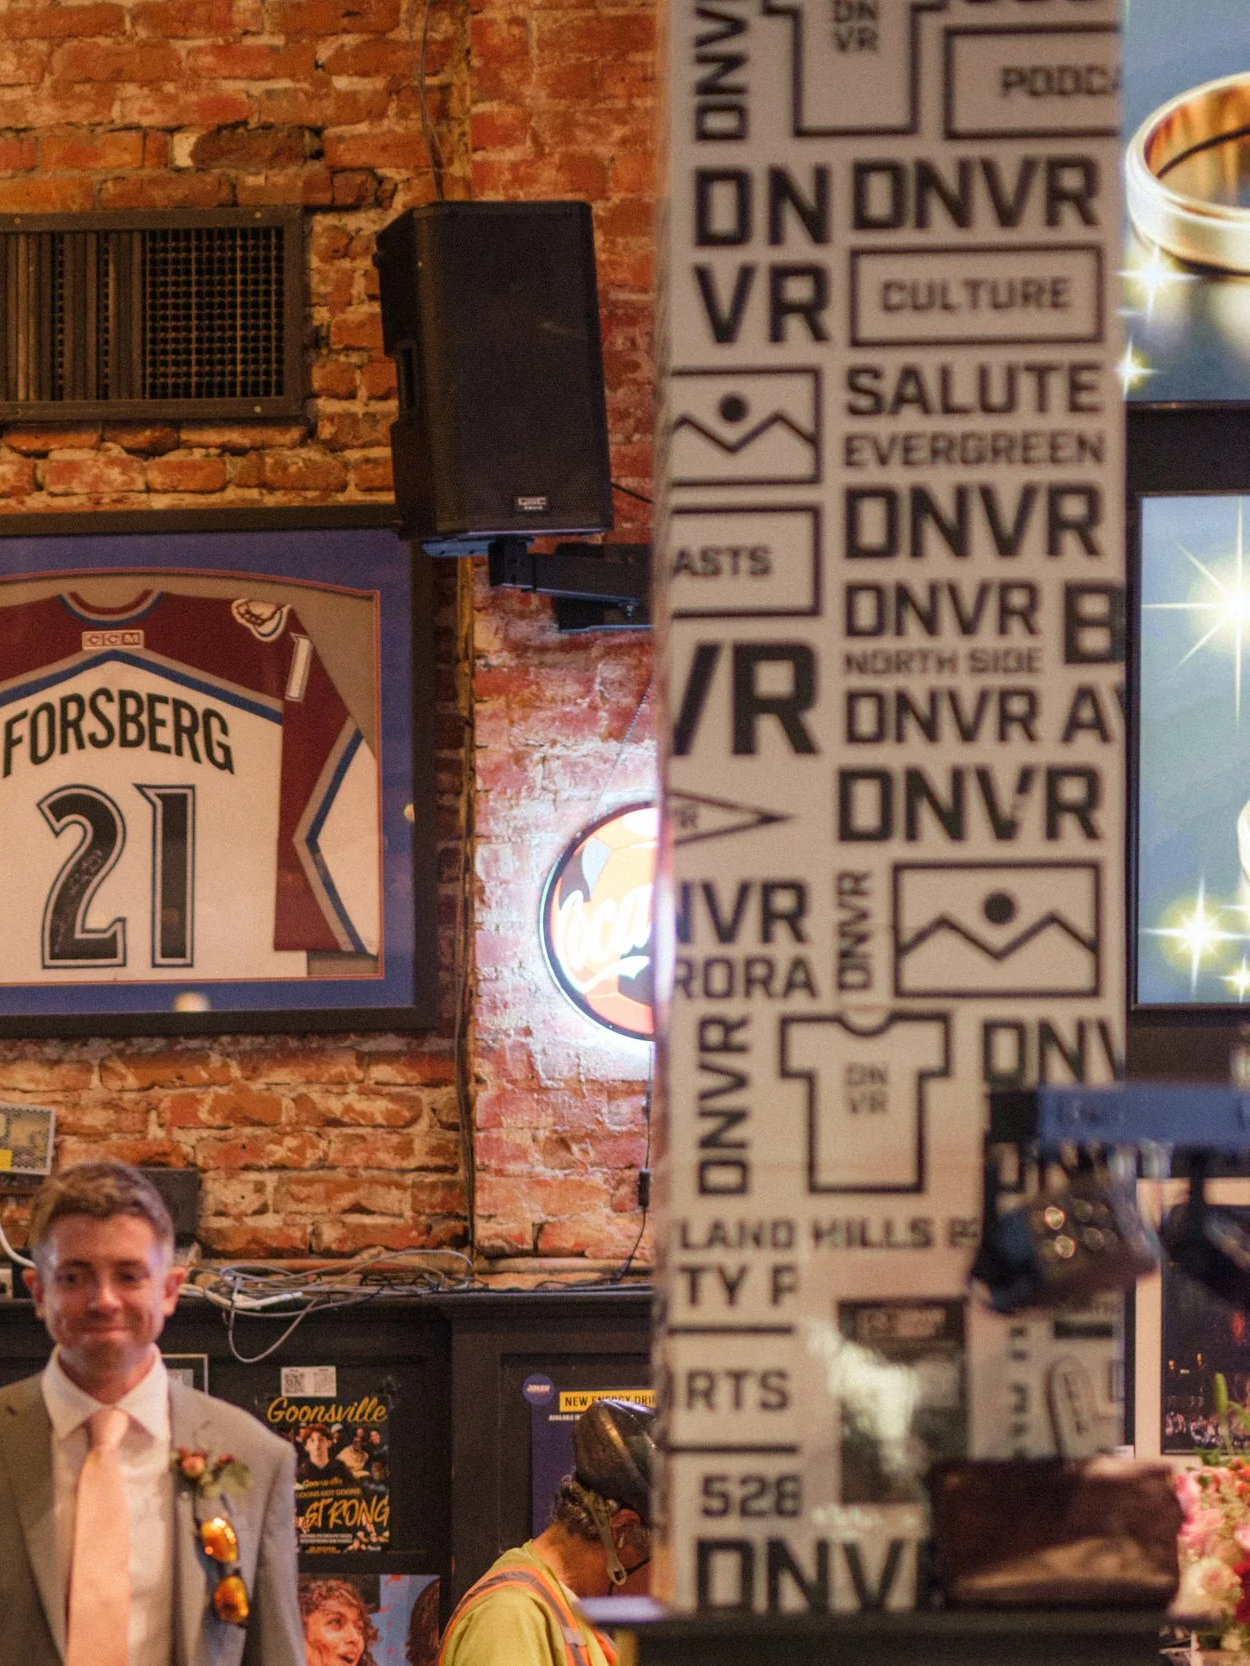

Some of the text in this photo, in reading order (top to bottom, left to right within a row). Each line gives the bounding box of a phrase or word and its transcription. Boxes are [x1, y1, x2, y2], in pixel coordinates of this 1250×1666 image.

[694, 0, 748, 141] DNV
[852, 154, 1099, 231] DNVR
[879, 278, 1071, 313] CULTURE
[846, 363, 1099, 417] SALUTE
[844, 431, 1105, 469] EVERGREEN
[845, 483, 1099, 560] DNVR
[672, 546, 772, 577] ASTS
[845, 579, 1041, 638] DNVR
[86, 631, 141, 647] CCM
[844, 647, 1042, 674] NORTH SIDE
[2, 687, 235, 779] FORSBERG
[845, 685, 1038, 744] DNVR
[837, 765, 1100, 842] DNVR
[37, 783, 196, 969] 21
[837, 868, 872, 992] DNVR
[697, 1013, 751, 1196] DNVR
[812, 1217, 932, 1249] HILLS
[267, 1397, 387, 1423] Goonsville
[565, 1396, 588, 1407] NEW
[664, 1369, 790, 1411] RTS
[302, 1494, 390, 1533] STRONG
